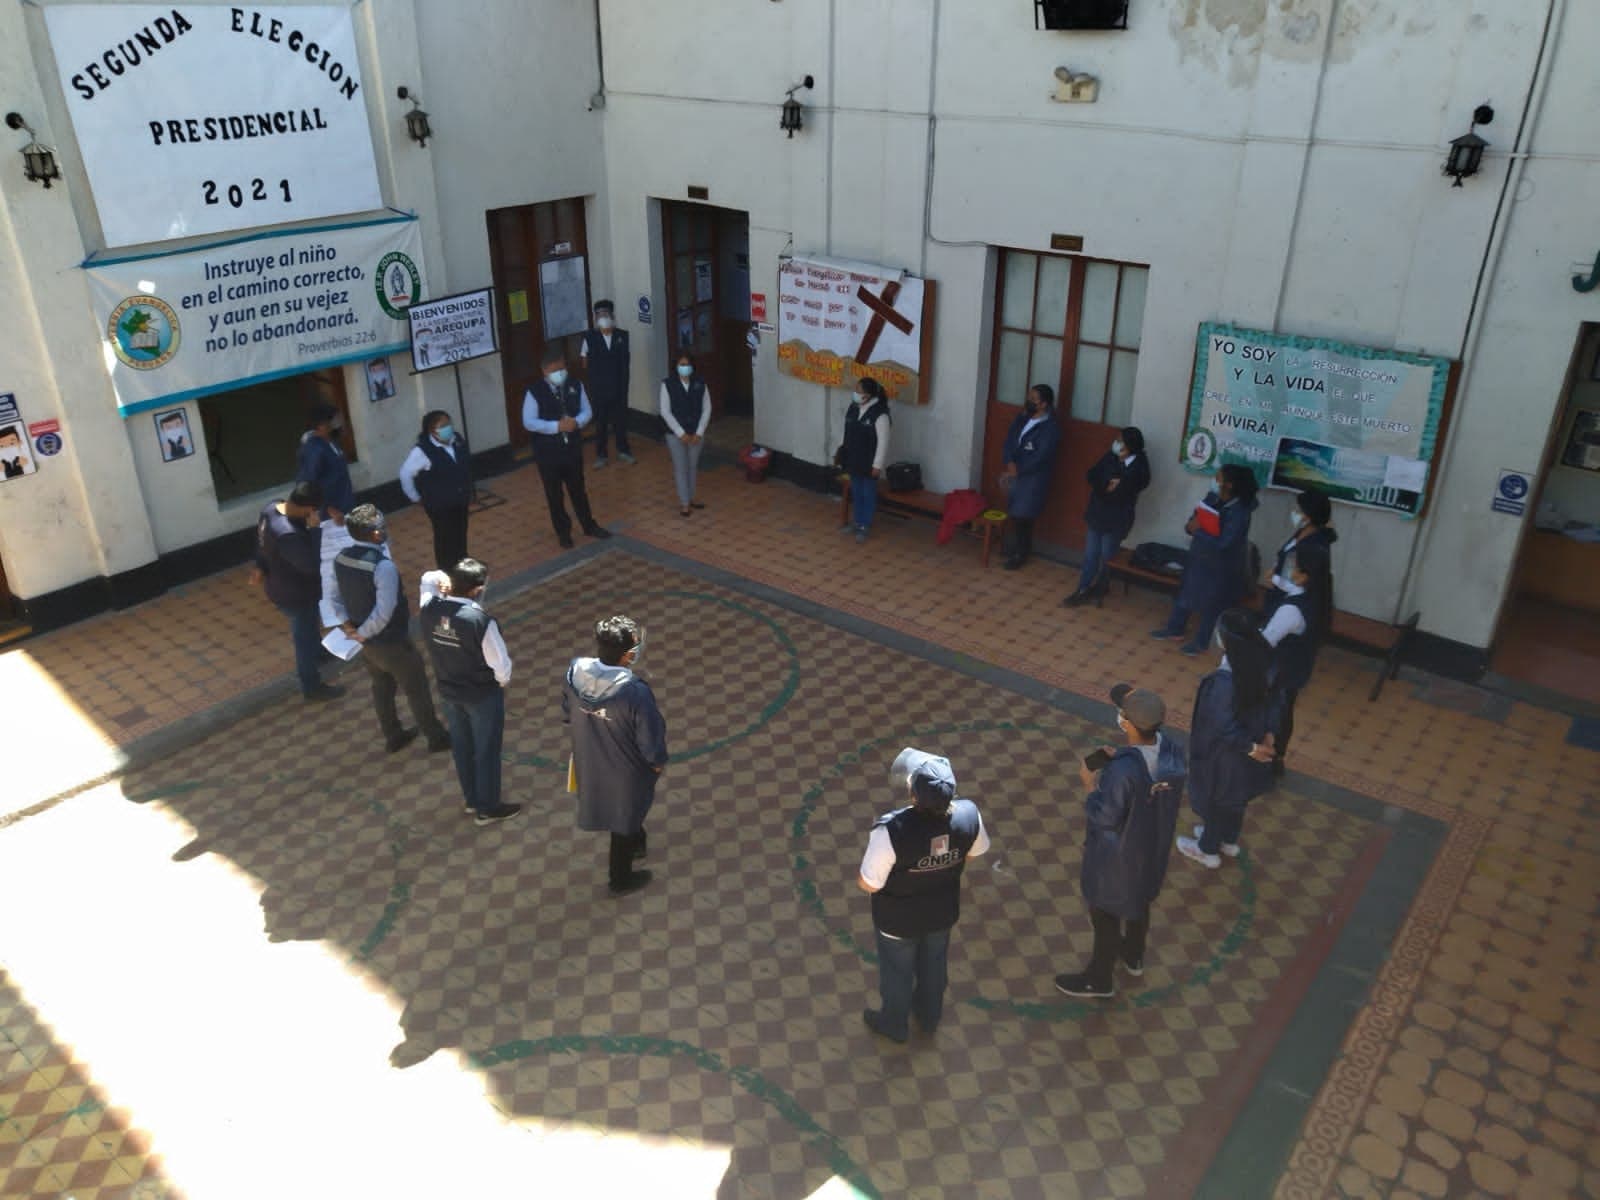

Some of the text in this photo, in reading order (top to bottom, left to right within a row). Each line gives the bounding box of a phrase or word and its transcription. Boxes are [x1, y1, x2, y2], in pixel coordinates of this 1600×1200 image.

[72, 8, 359, 100] SEGUNDA ELECCION
[149, 108, 328, 145] PRESIDENCIAL
[202, 178, 292, 208] 2021
[205, 244, 336, 281] Instruye al niño
[181, 265, 365, 309] en el camino correcto,
[209, 290, 349, 333] y aun en su vejez
[412, 298, 486, 321] BIENVENIDOS
[205, 308, 359, 352] no lo abandonará.
[435, 317, 487, 334] AREQUIPA
[298, 330, 377, 356] Proverbios 22:6
[1213, 338, 1235, 354] YO
[1241, 345, 1276, 363] SOY
[1233, 367, 1244, 380] Y
[1254, 371, 1275, 386] LA
[1212, 412, 1275, 437] ¡VIVIRÁ!
